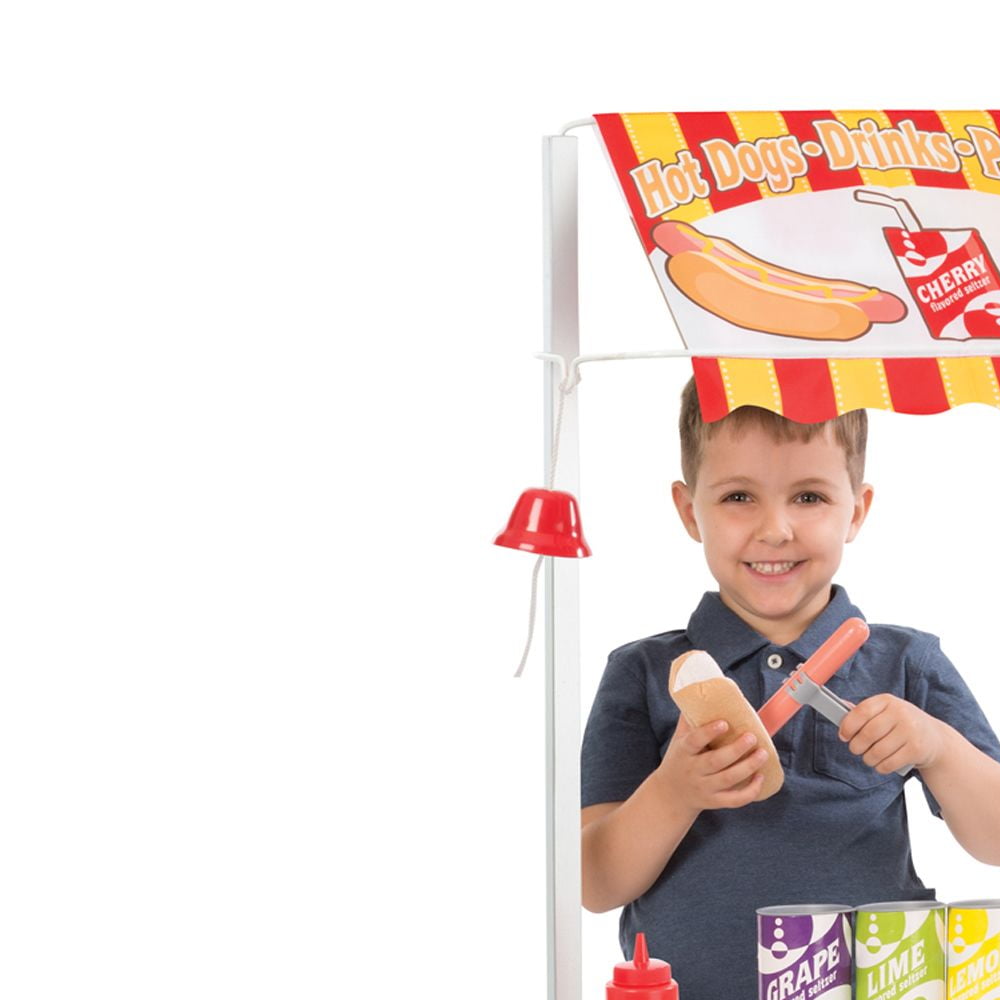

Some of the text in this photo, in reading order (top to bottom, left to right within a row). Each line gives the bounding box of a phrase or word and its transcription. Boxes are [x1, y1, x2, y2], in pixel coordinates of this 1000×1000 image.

[629, 149, 711, 219] Hot
[700, 135, 809, 193] Dogs
[811, 118, 961, 173] Drinks
[916, 253, 988, 304] CHERRY
[929, 276, 991, 313] flavored seltzer
[808, 970, 838, 998] seltzer
[867, 939, 925, 998] LIME
[899, 966, 928, 992] seltzer
